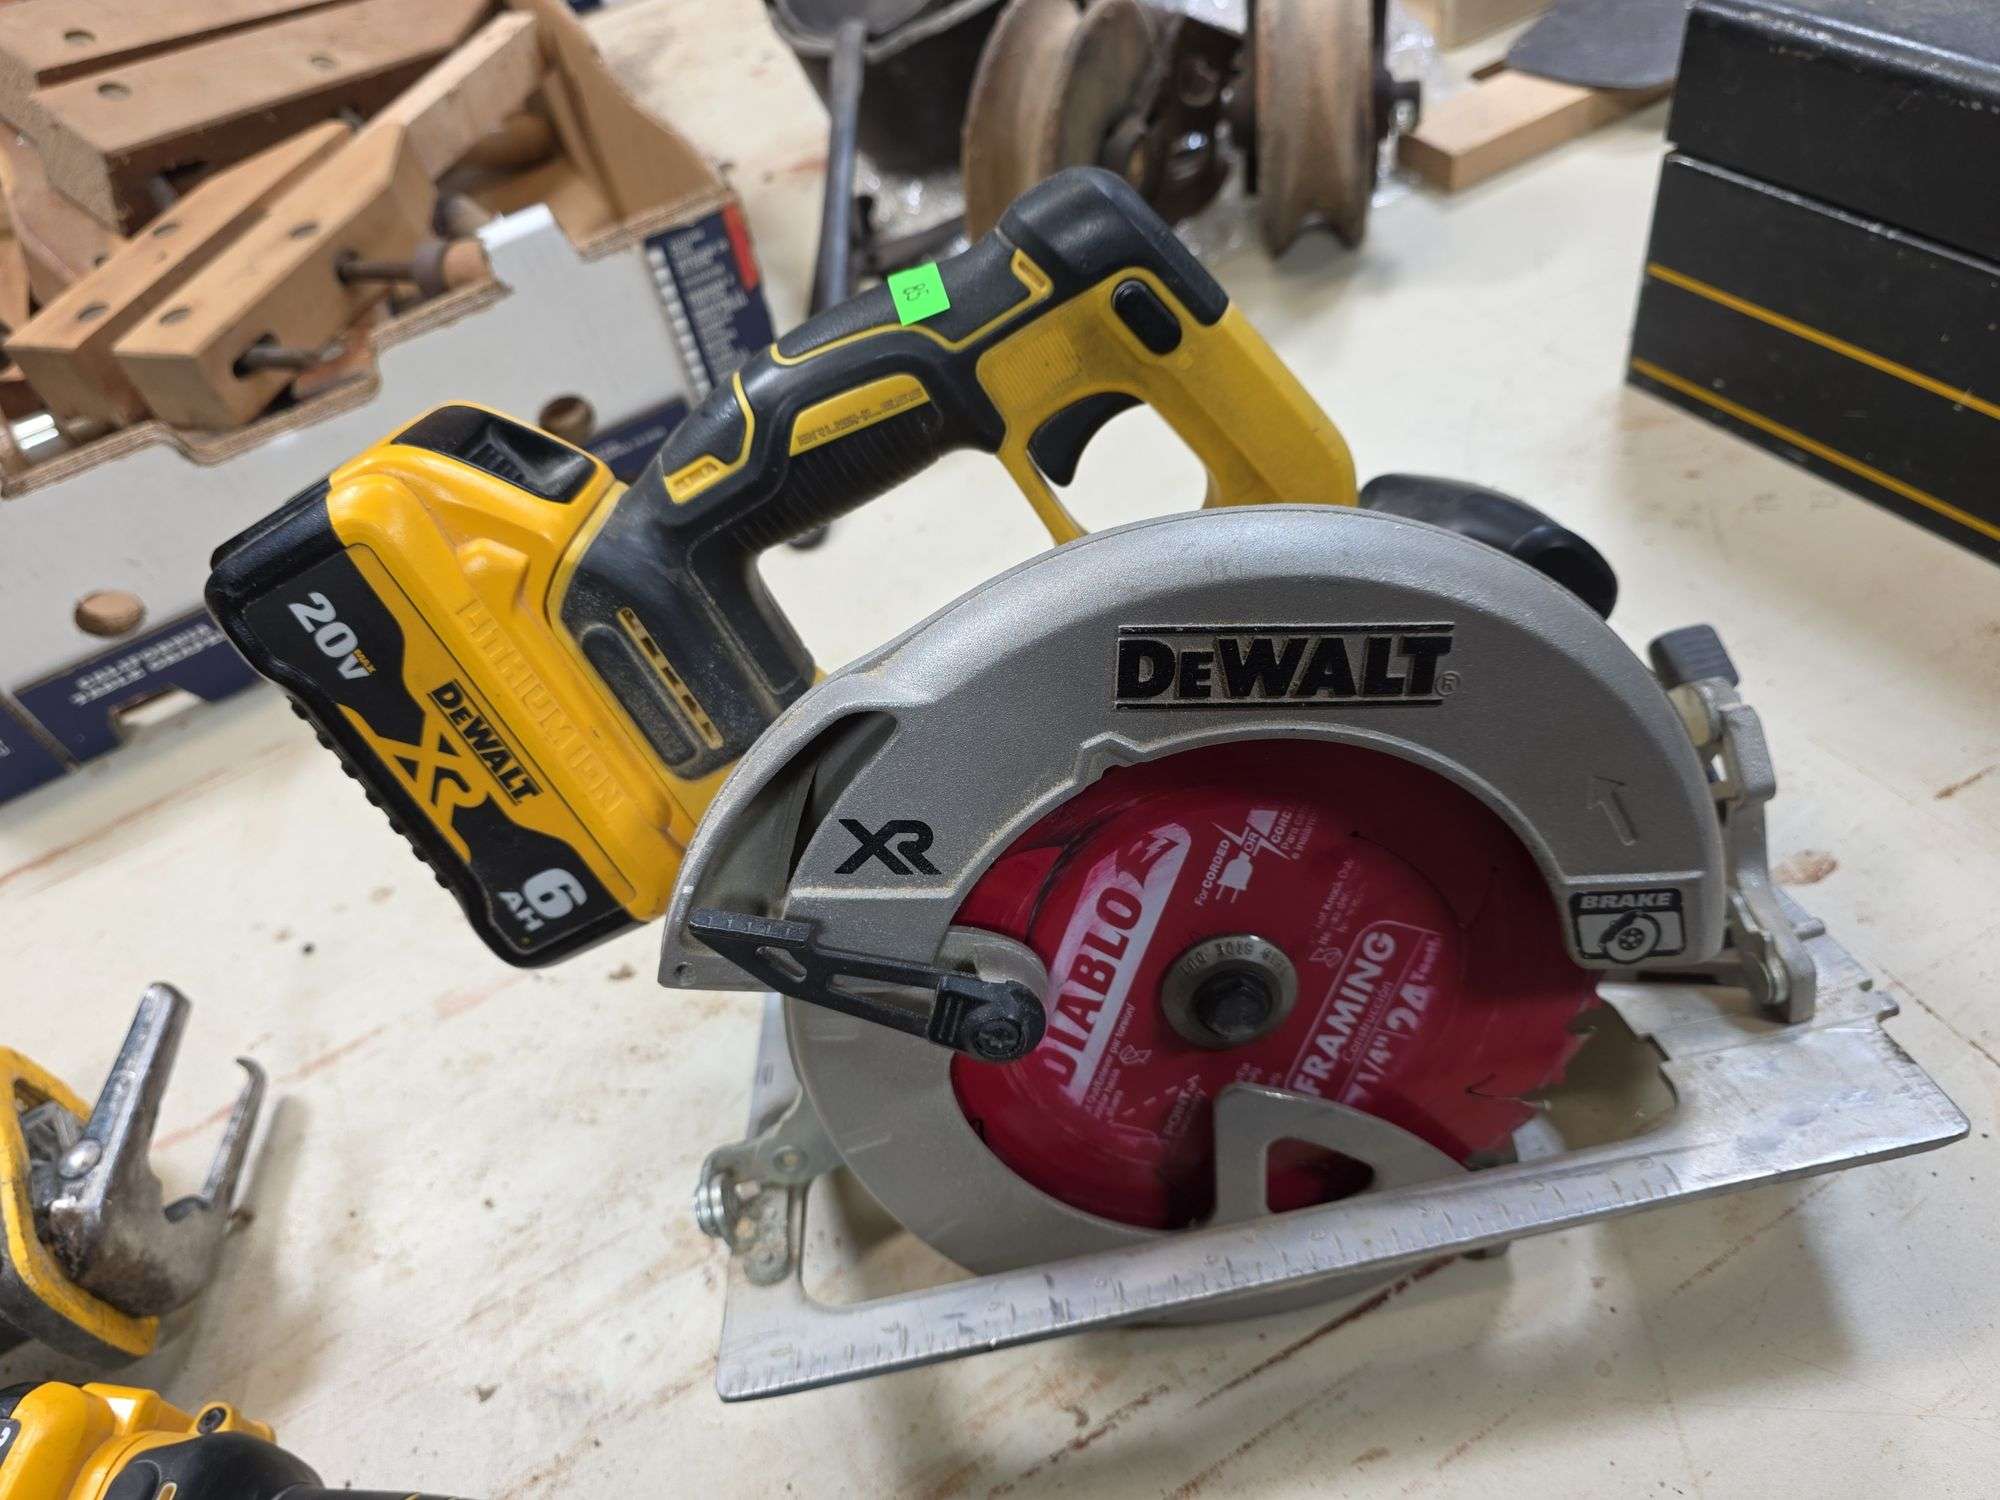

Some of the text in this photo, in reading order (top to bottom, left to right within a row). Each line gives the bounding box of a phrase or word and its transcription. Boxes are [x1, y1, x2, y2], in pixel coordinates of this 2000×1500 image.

[457, 597, 626, 816] LITHIUM ION
[834, 818, 942, 875] XR
[1202, 839, 1230, 889] CORDED
[1243, 831, 1259, 852] OR
[497, 891, 543, 931] AH
[524, 868, 586, 918] 6
[1579, 891, 1674, 909] BRAKE
[1040, 886, 1143, 1088] DIABLO
[1386, 983, 1432, 1031] 24
[1293, 931, 1396, 1095] FRAMING
